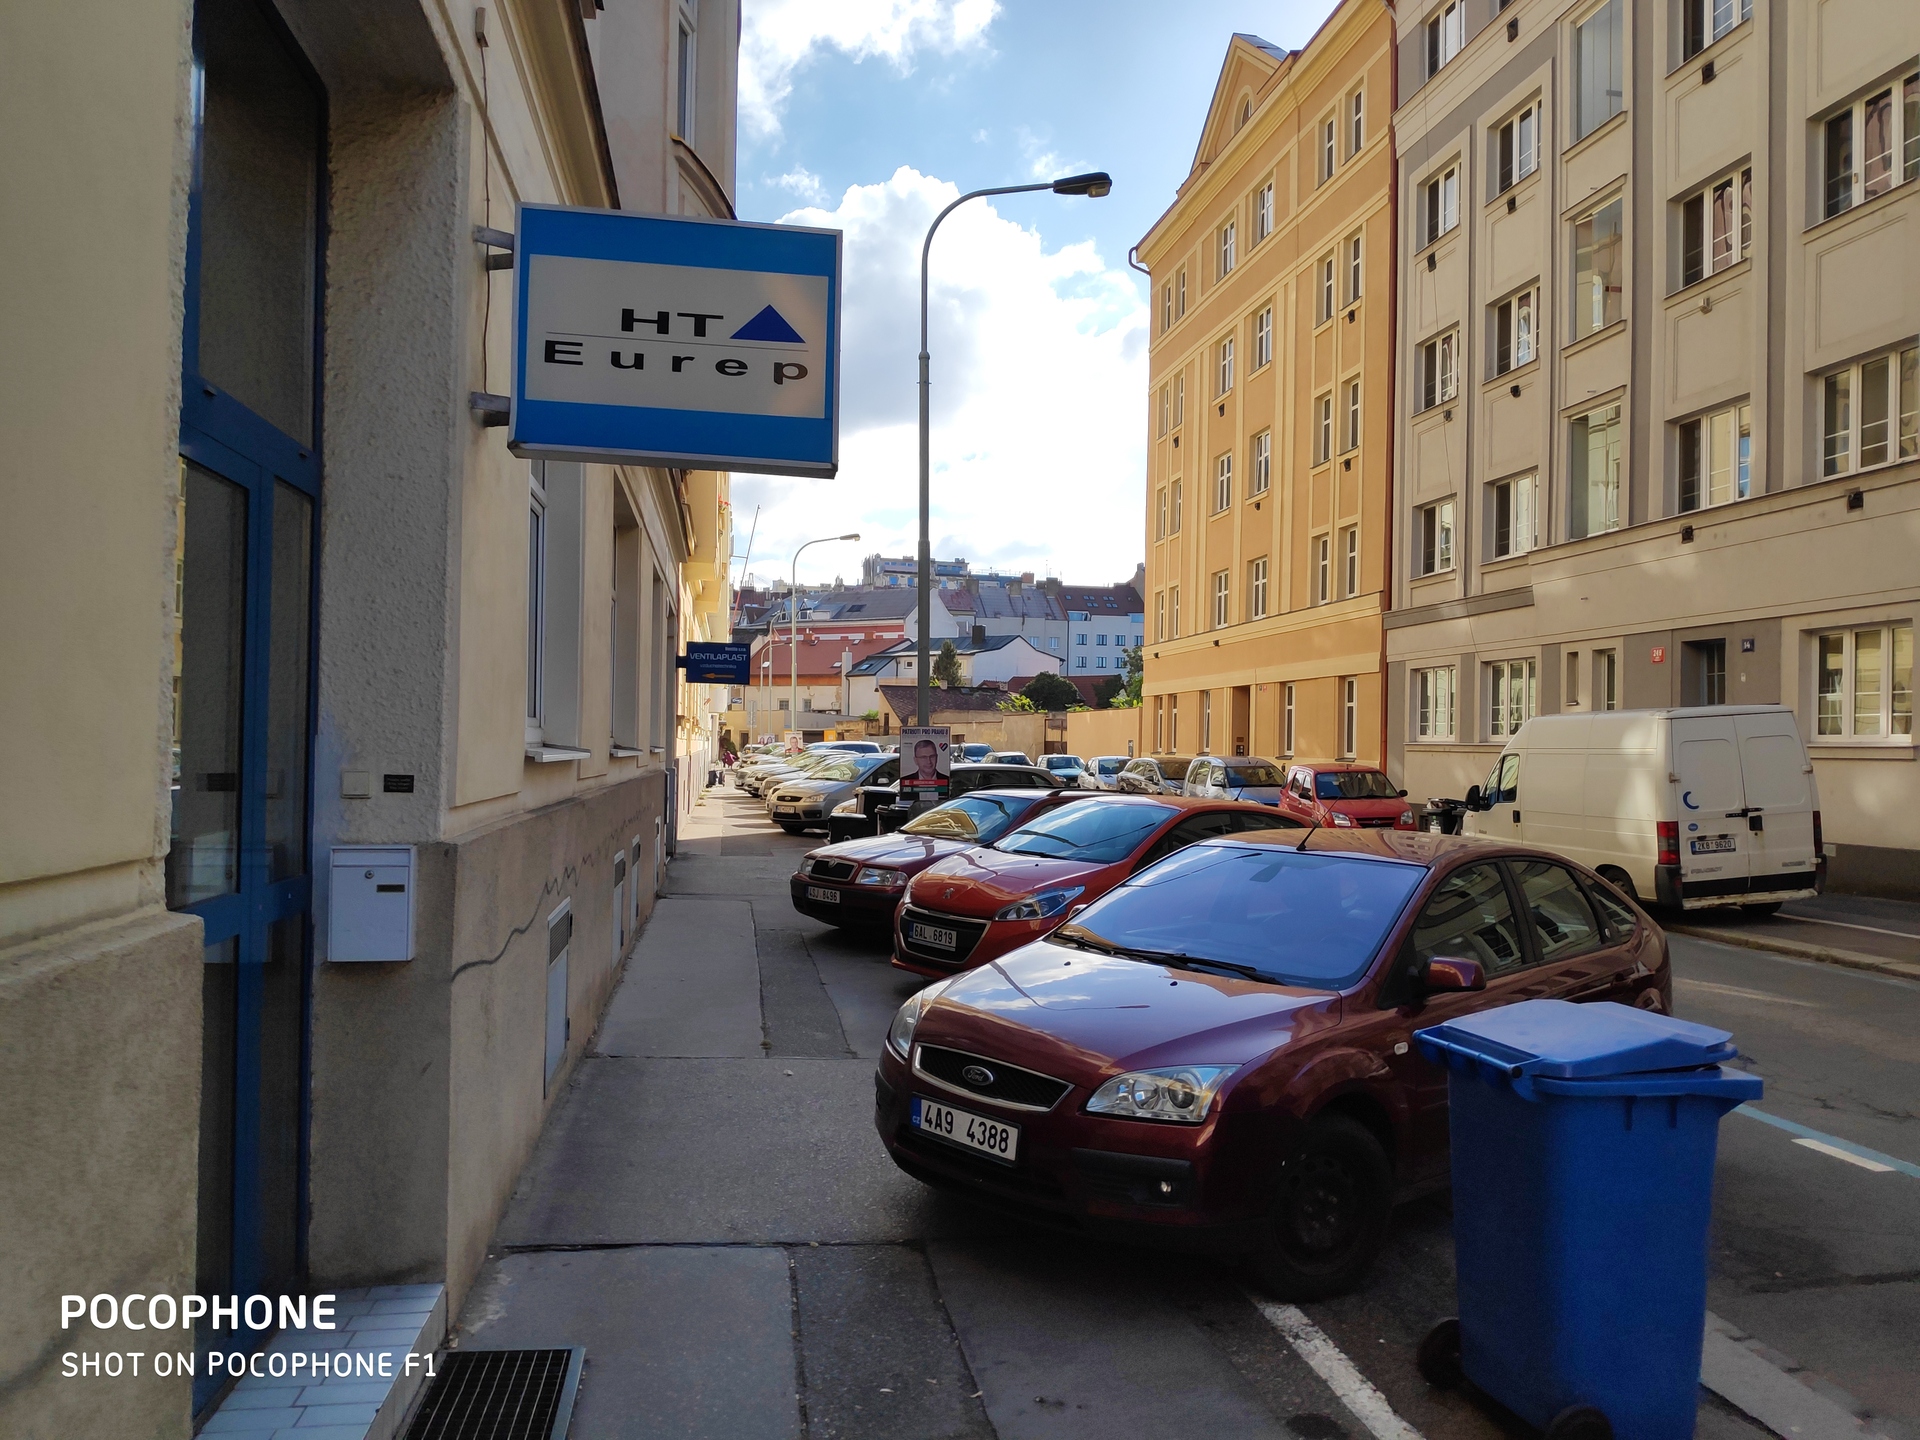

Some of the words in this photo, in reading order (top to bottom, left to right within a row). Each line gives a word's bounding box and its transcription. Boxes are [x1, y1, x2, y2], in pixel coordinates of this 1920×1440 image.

[621, 308, 724, 337] HT
[544, 339, 809, 385] Eurep
[1743, 641, 1751, 649] 14
[689, 652, 747, 661] VENTILAPLAST
[1715, 840, 1732, 849] 9620
[822, 890, 838, 902] 8496
[914, 925, 928, 940] 6AL
[933, 929, 953, 944] 6819
[967, 1069, 985, 1082] Ford
[924, 1105, 954, 1135] 4A9
[966, 1118, 1010, 1154] 4388
